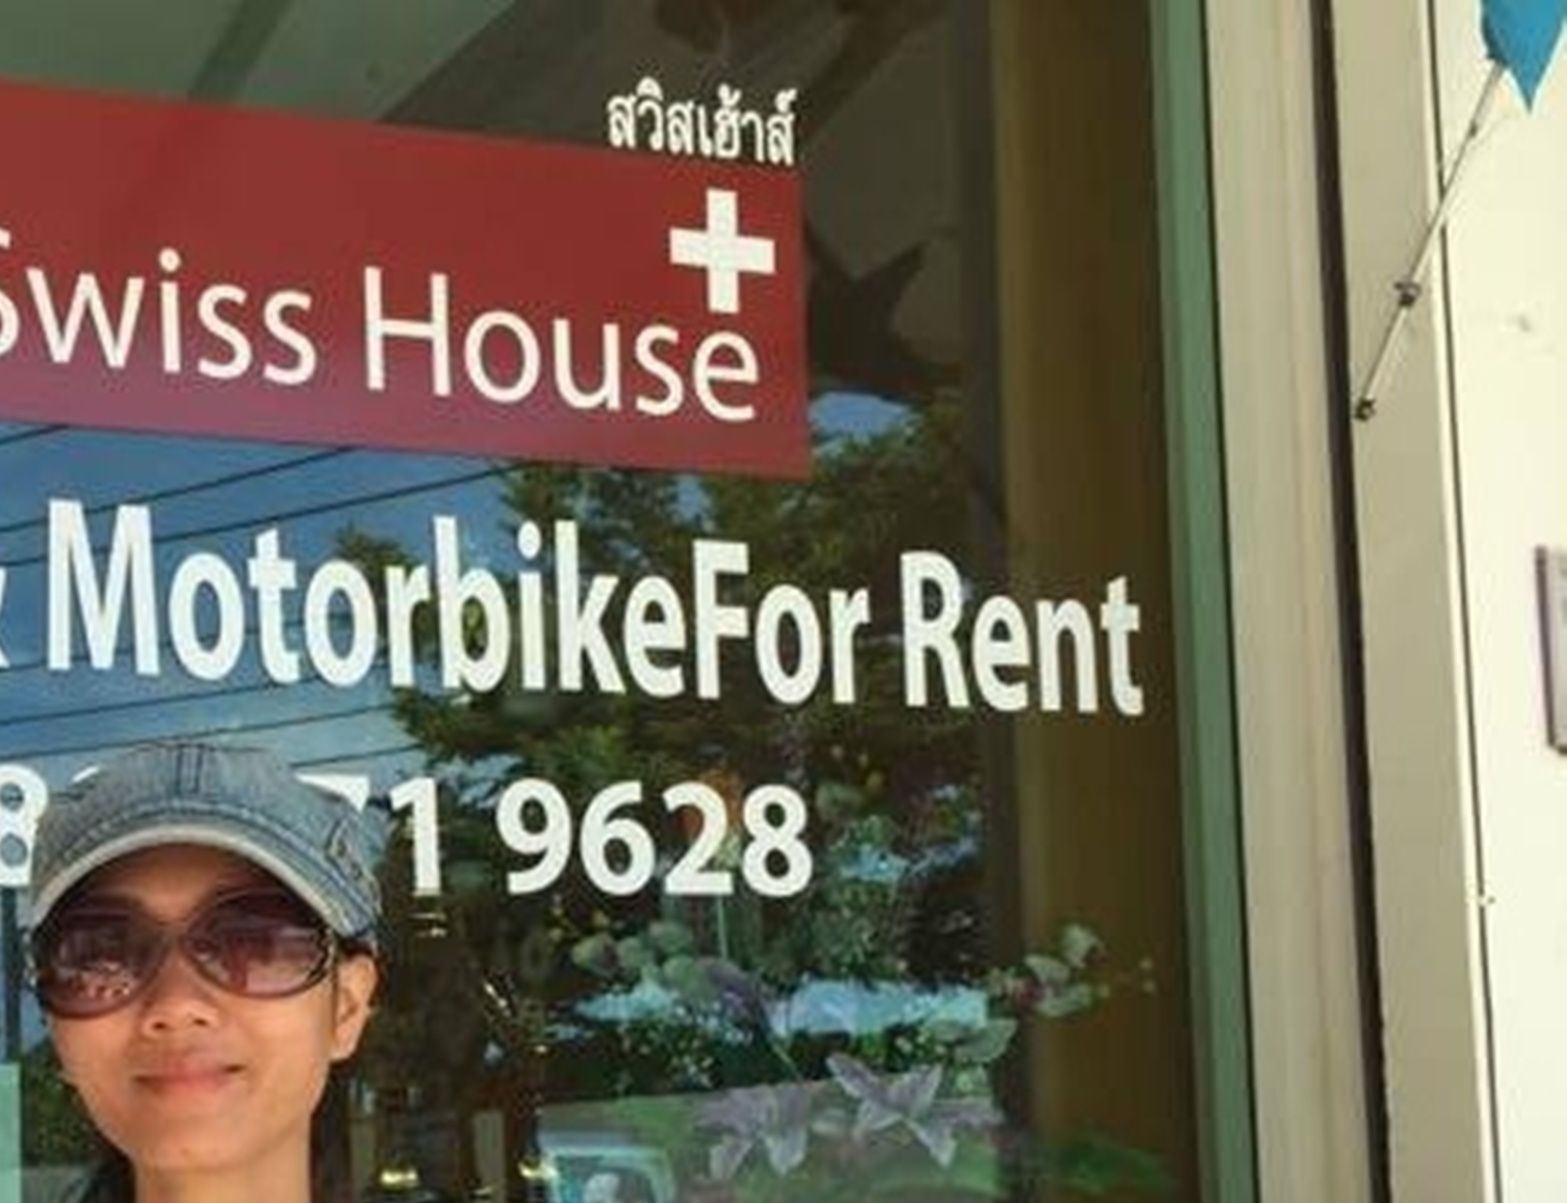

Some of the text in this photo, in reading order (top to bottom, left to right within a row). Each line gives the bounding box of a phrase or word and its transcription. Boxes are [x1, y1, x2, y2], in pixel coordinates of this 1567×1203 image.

[606, 76, 799, 167] สวิสเฮ้าส์
[364, 266, 760, 422] House
[900, 552, 1143, 715] Rent
[497, 778, 813, 897] 9628
